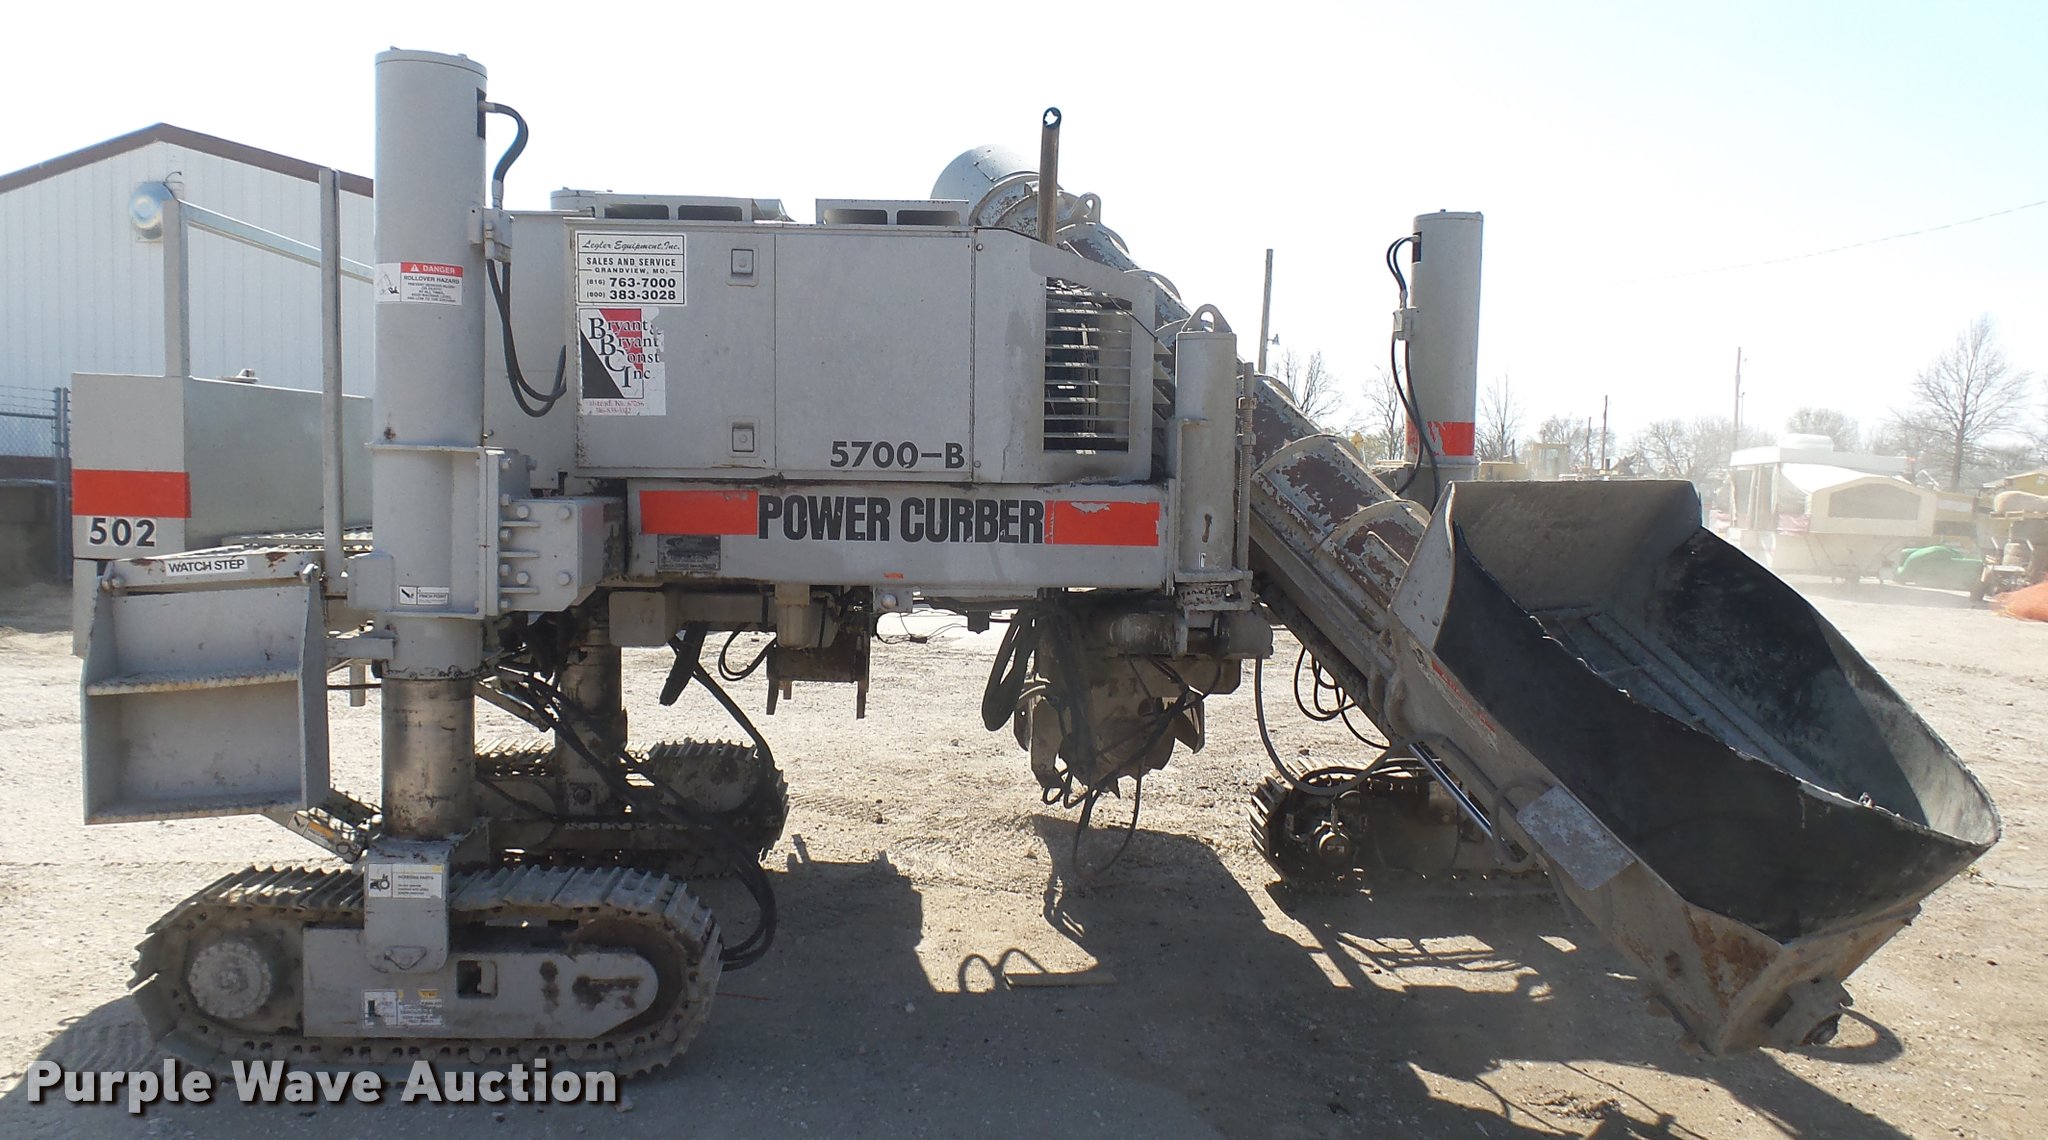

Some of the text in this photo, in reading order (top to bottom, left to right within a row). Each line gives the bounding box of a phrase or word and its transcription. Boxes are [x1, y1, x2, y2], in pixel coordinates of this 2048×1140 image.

[581, 240, 612, 251] Legler
[586, 257, 676, 267] SALES AND SERVICE
[422, 265, 456, 274] DANGER
[436, 277, 460, 285] HAZARD
[609, 277, 676, 288] 763-7000
[609, 290, 676, 300] 383-3028
[588, 317, 648, 340] Bryant
[599, 334, 659, 356] Bryant
[622, 366, 651, 388] Inc
[830, 441, 965, 469] 5700-B
[758, 494, 1045, 544] POWER CURBER
[89, 517, 156, 547] 502
[168, 559, 245, 573] WATCH STEP
